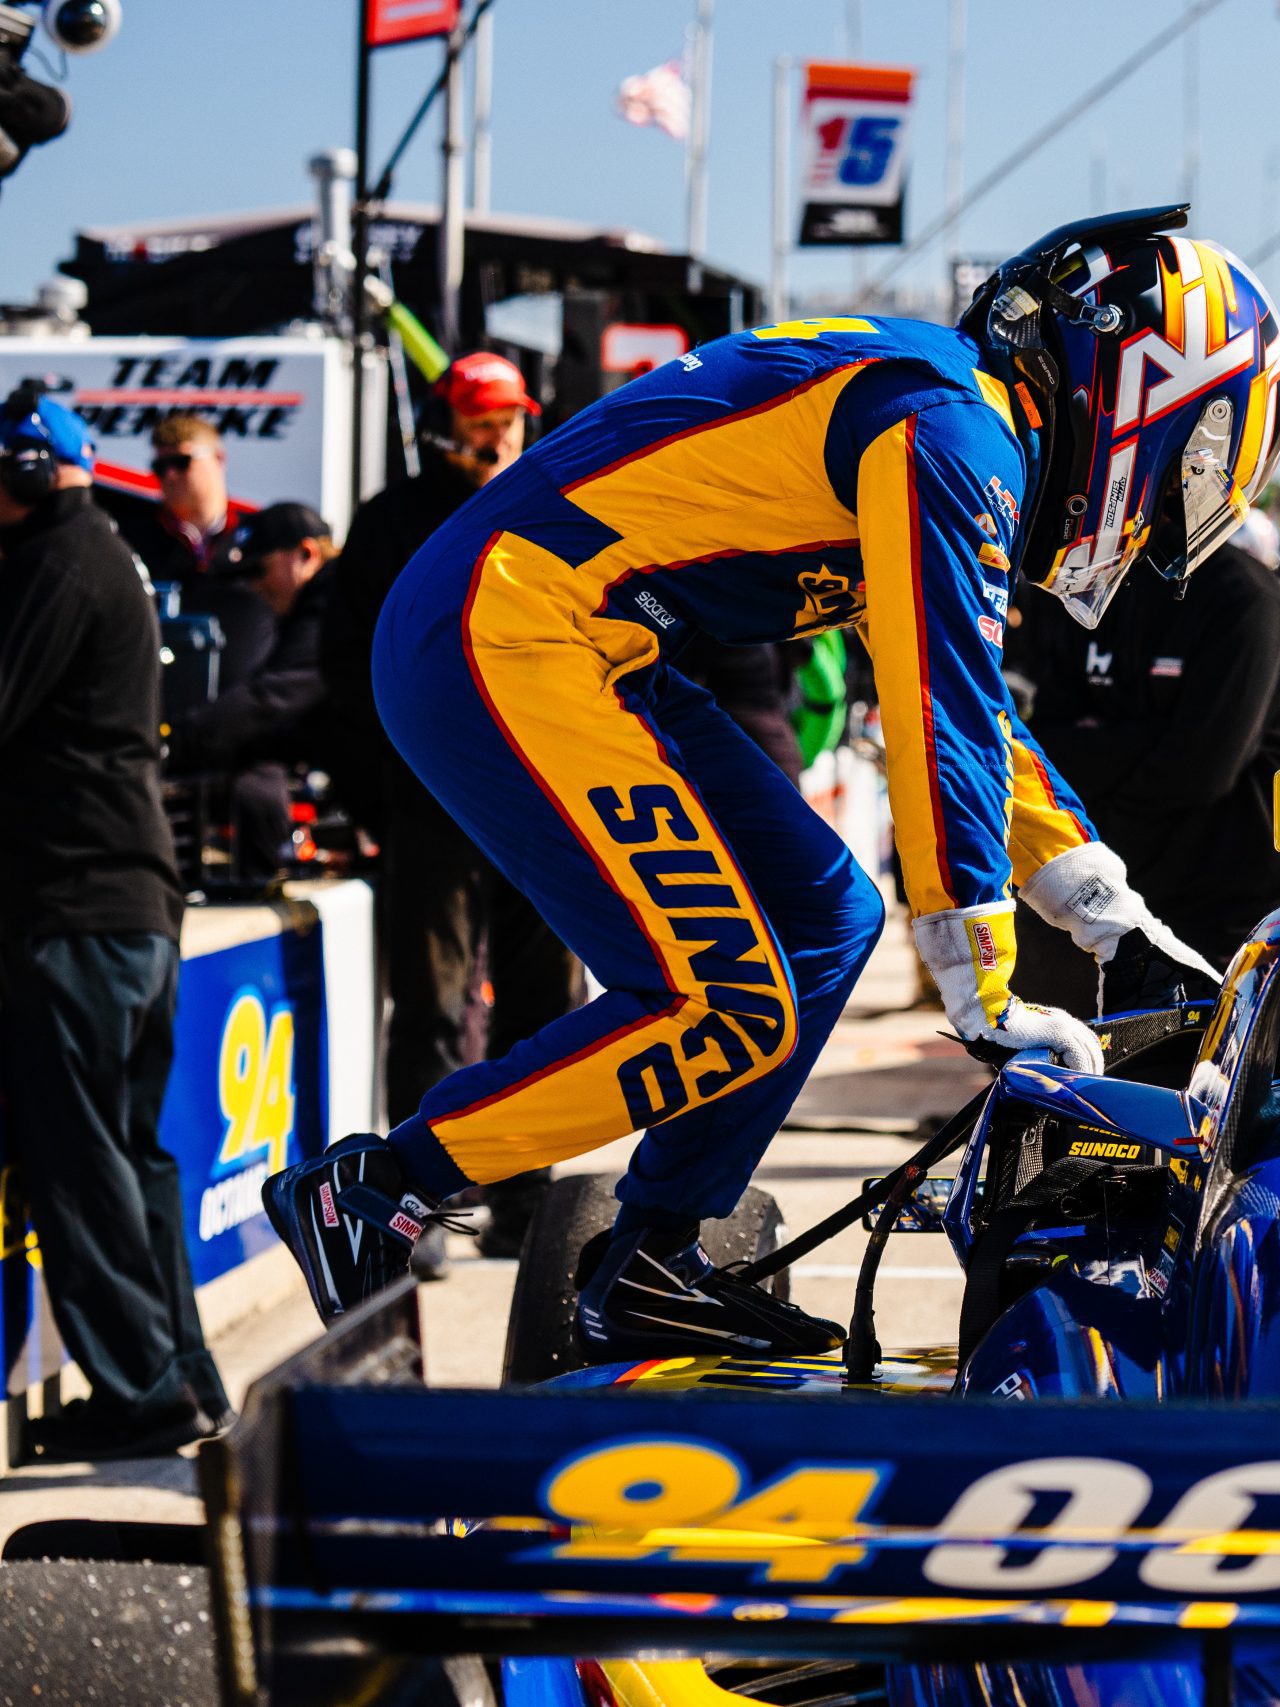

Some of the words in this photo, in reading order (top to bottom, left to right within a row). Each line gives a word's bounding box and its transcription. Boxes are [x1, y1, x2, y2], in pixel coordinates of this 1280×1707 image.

[809, 116, 900, 186] 15
[110, 357, 282, 388] TEAM
[1105, 480, 1121, 528] SIMPSON
[634, 590, 676, 629] sparco
[976, 926, 995, 967] SIMPSON
[1187, 1010, 1200, 1022] 94
[219, 994, 294, 1173] 94
[1068, 1141, 1141, 1160] SUNOCO
[321, 1185, 337, 1225] SIMPSON
[548, 1441, 880, 1583] 94
